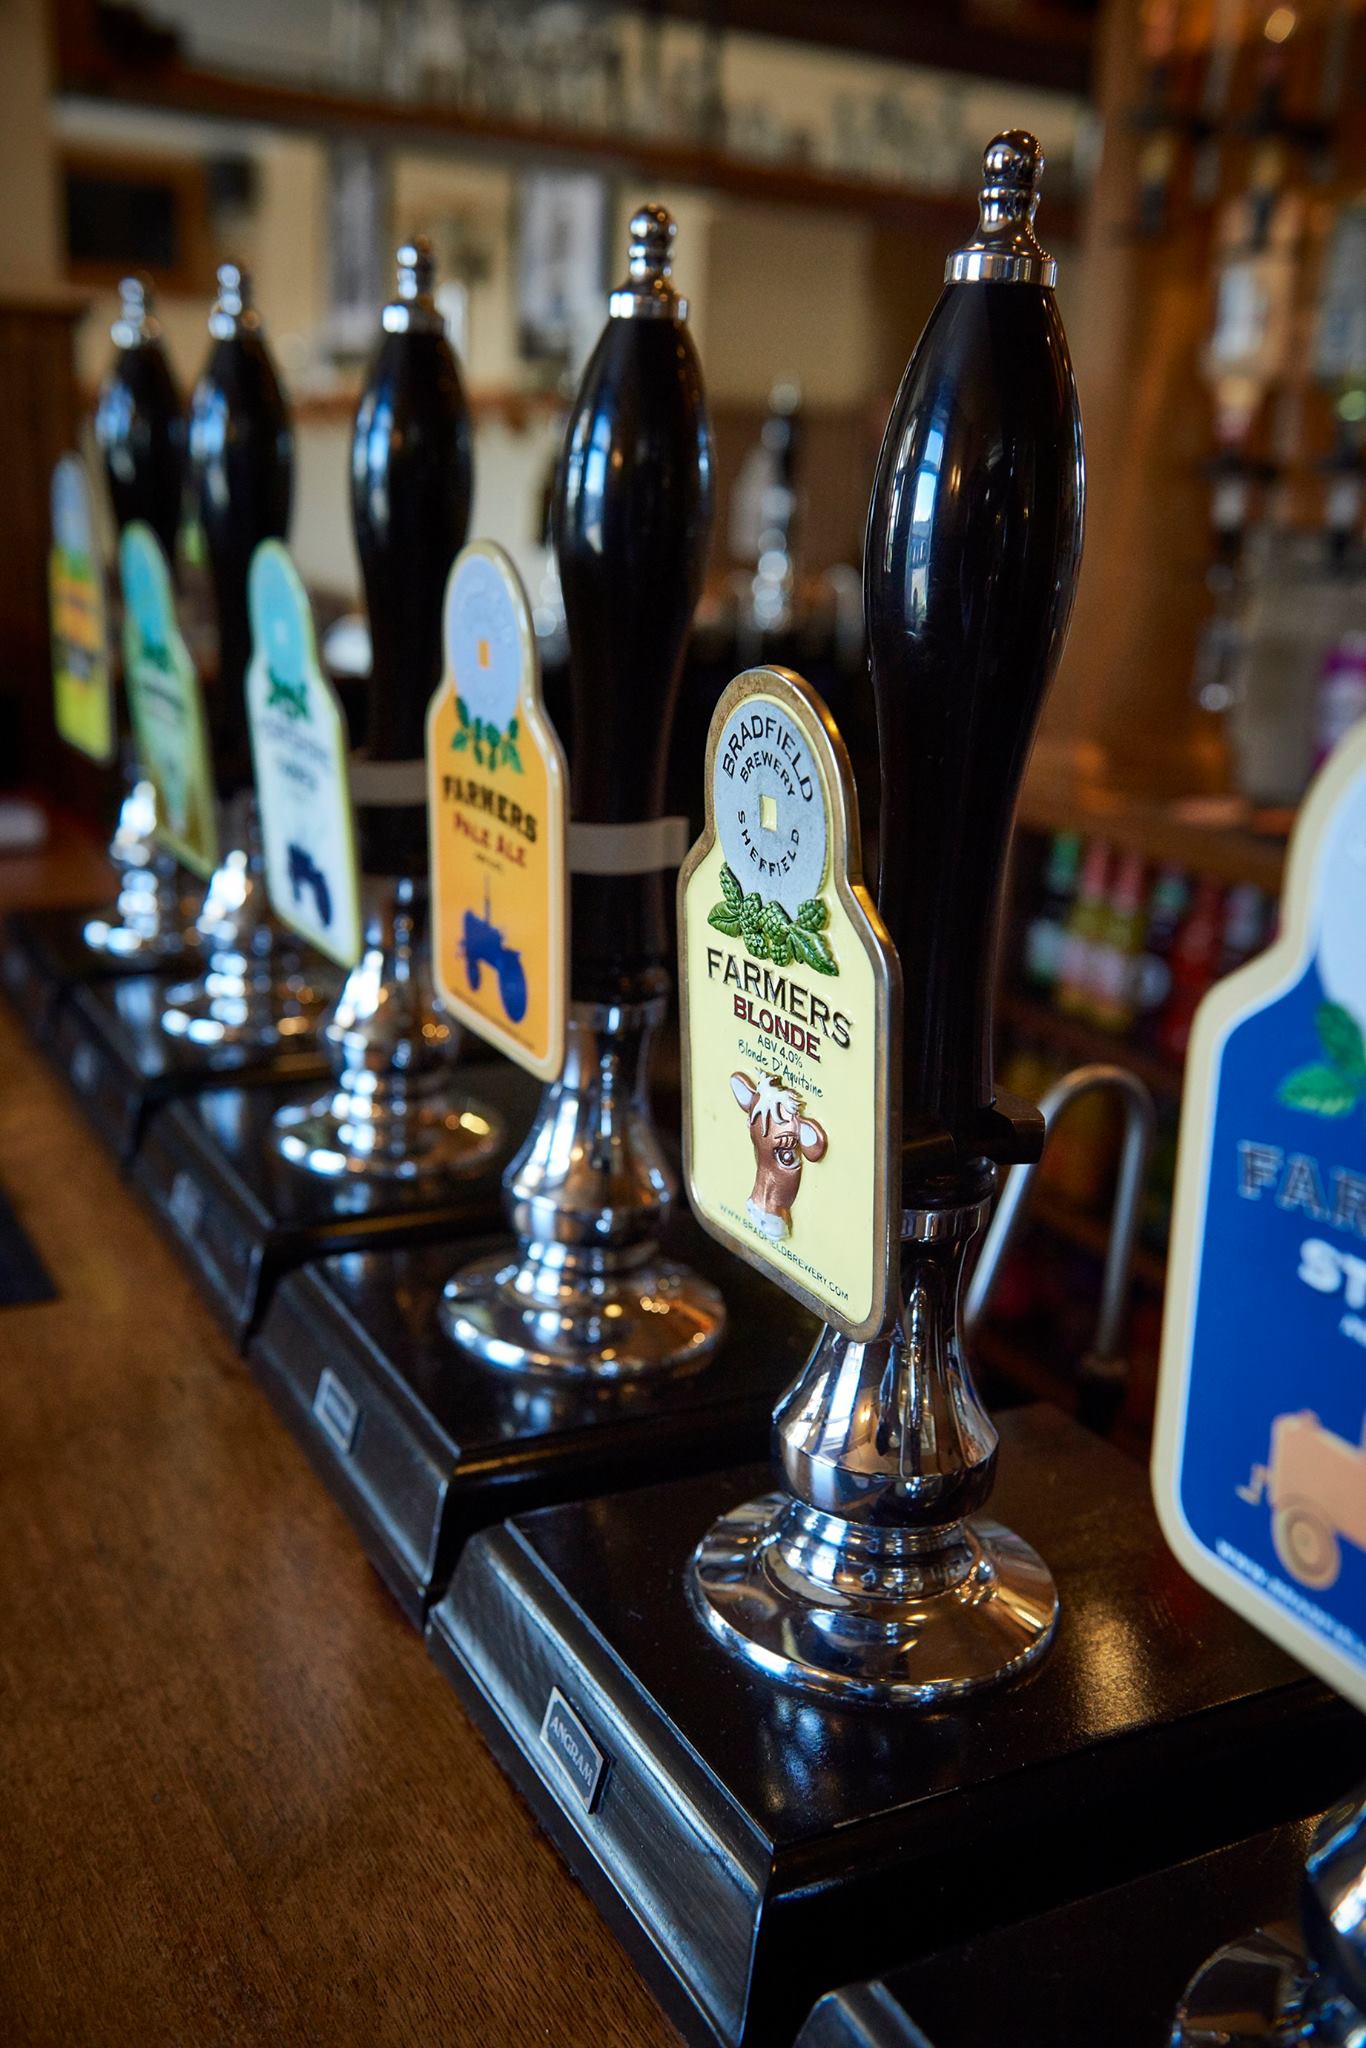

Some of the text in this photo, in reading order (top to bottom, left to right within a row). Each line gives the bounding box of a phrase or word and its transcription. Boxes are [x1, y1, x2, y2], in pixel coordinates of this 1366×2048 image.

[722, 714, 814, 803] BRADFIELD
[739, 750, 796, 797] BREWERY
[443, 775, 537, 843] FARMERS
[737, 809, 800, 877] SHEFFIELD
[496, 832, 527, 869] ALE
[706, 947, 854, 1050] FARMERS
[733, 993, 821, 1064] BLONDE
[737, 1039, 769, 1066] Blonde
[757, 1034, 803, 1068] ABV 4.0%
[550, 1716, 594, 1787] ANGRAM
